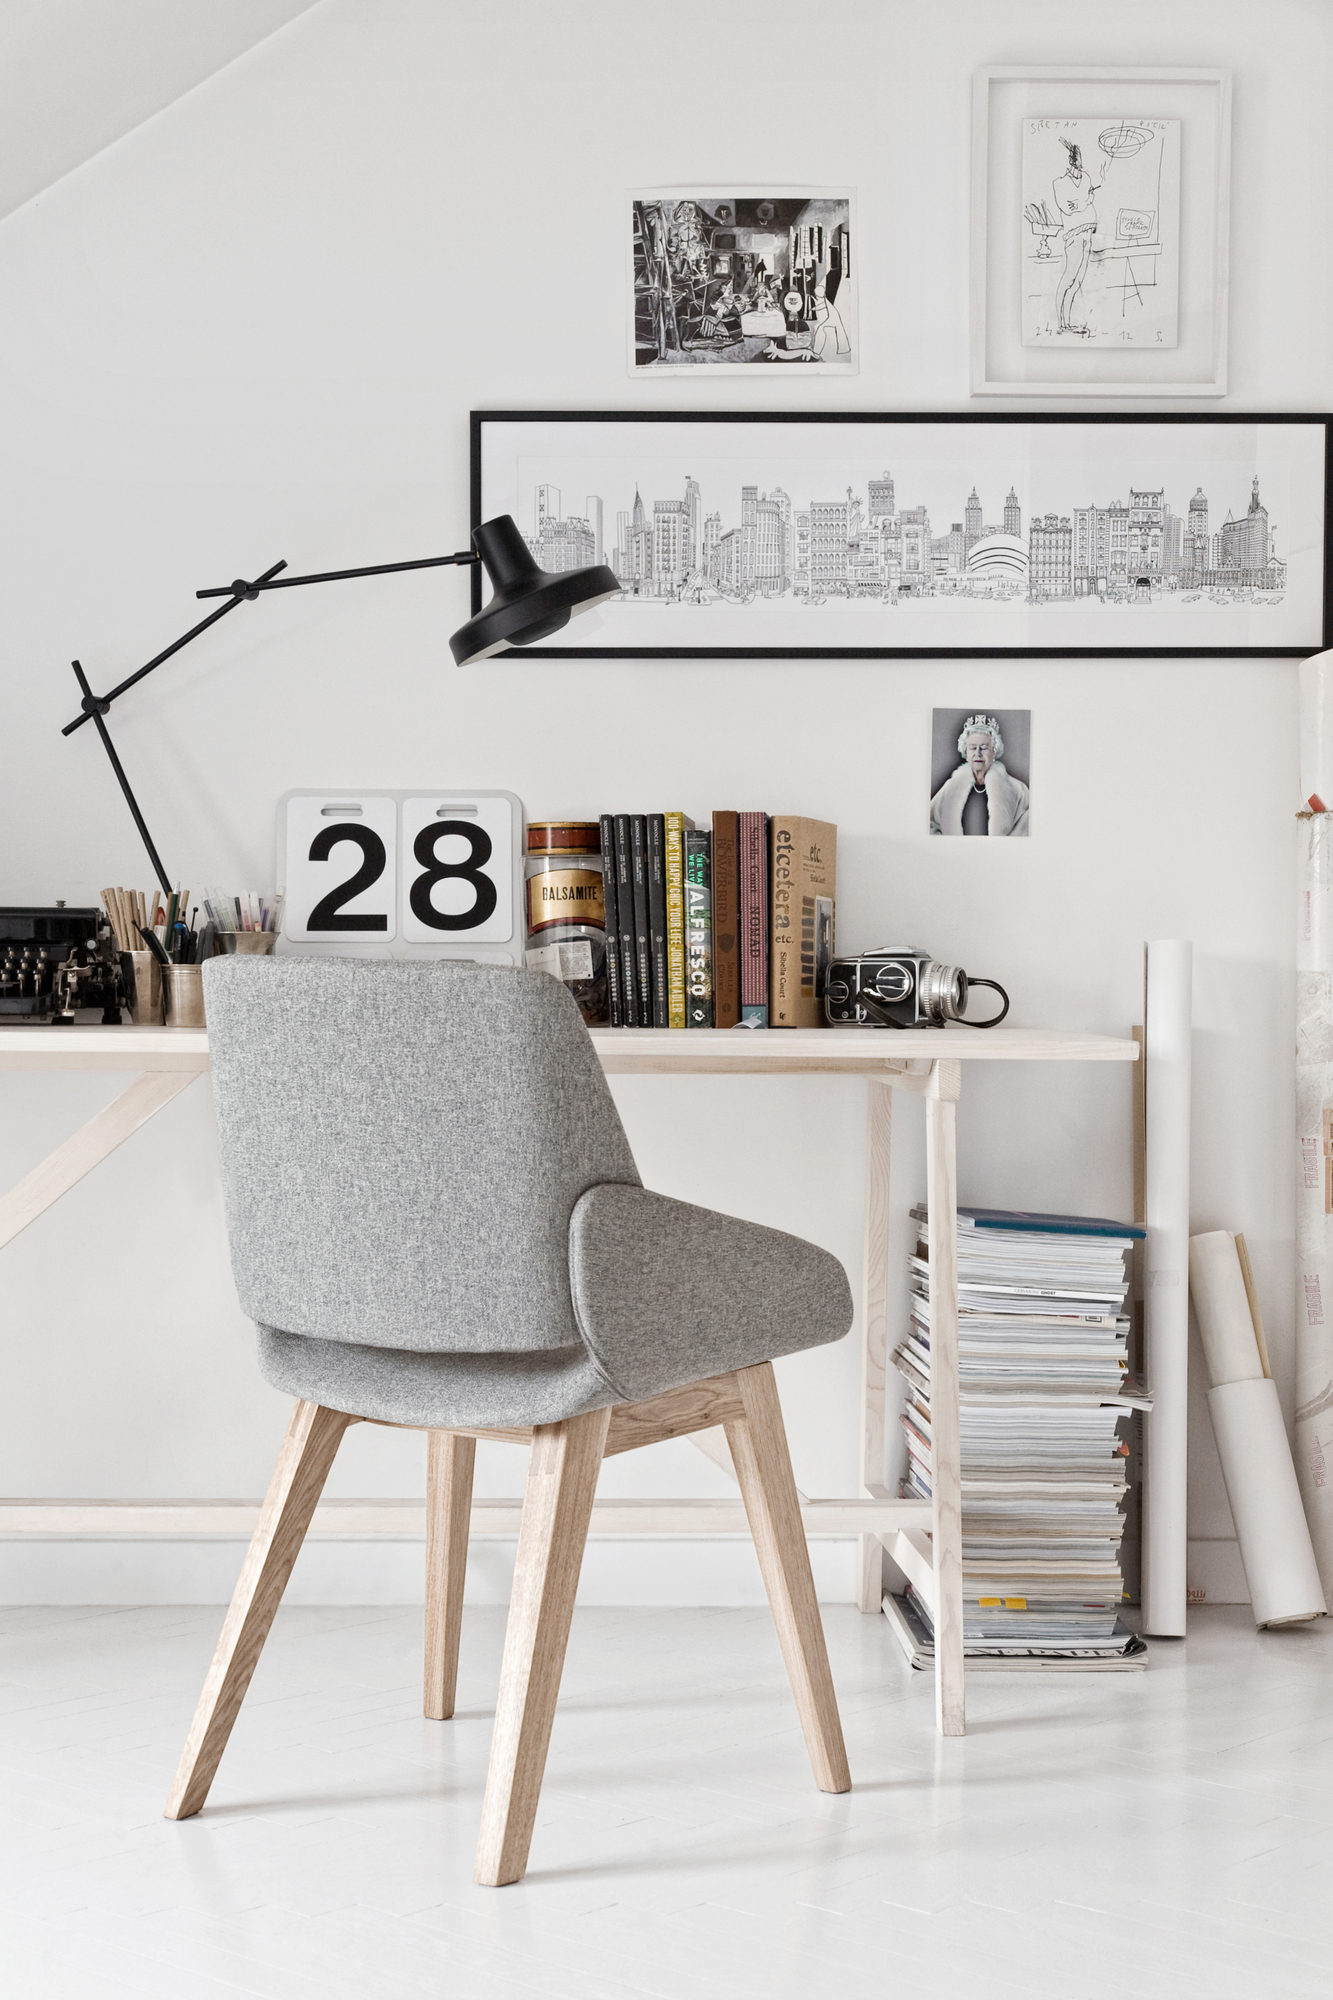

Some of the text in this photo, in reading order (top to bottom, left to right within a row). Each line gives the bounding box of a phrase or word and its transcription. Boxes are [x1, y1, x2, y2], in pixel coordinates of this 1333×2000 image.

[667, 816, 679, 829] 100
[668, 830, 680, 850] WAYS
[668, 852, 680, 861] TO
[688, 854, 695, 866] WE
[749, 827, 760, 893] Sibella Court
[669, 863, 681, 887] HAPPY
[716, 838, 728, 923] BOWERBIRD
[775, 829, 795, 930] etcetera
[542, 885, 598, 902] BALSAMITE
[669, 888, 681, 906] CHIC
[670, 907, 681, 928] YOUR
[690, 890, 705, 996] ALFRESCO
[749, 906, 761, 958] NOMAD
[775, 934, 795, 944] etc.
[671, 947, 682, 987] JONATHAN
[779, 952, 788, 999] Sibella Court
[671, 989, 683, 1013] ADLER
[1301, 1137, 1319, 1189] FRAGILE
[1303, 1274, 1324, 1326] FRAGILE
